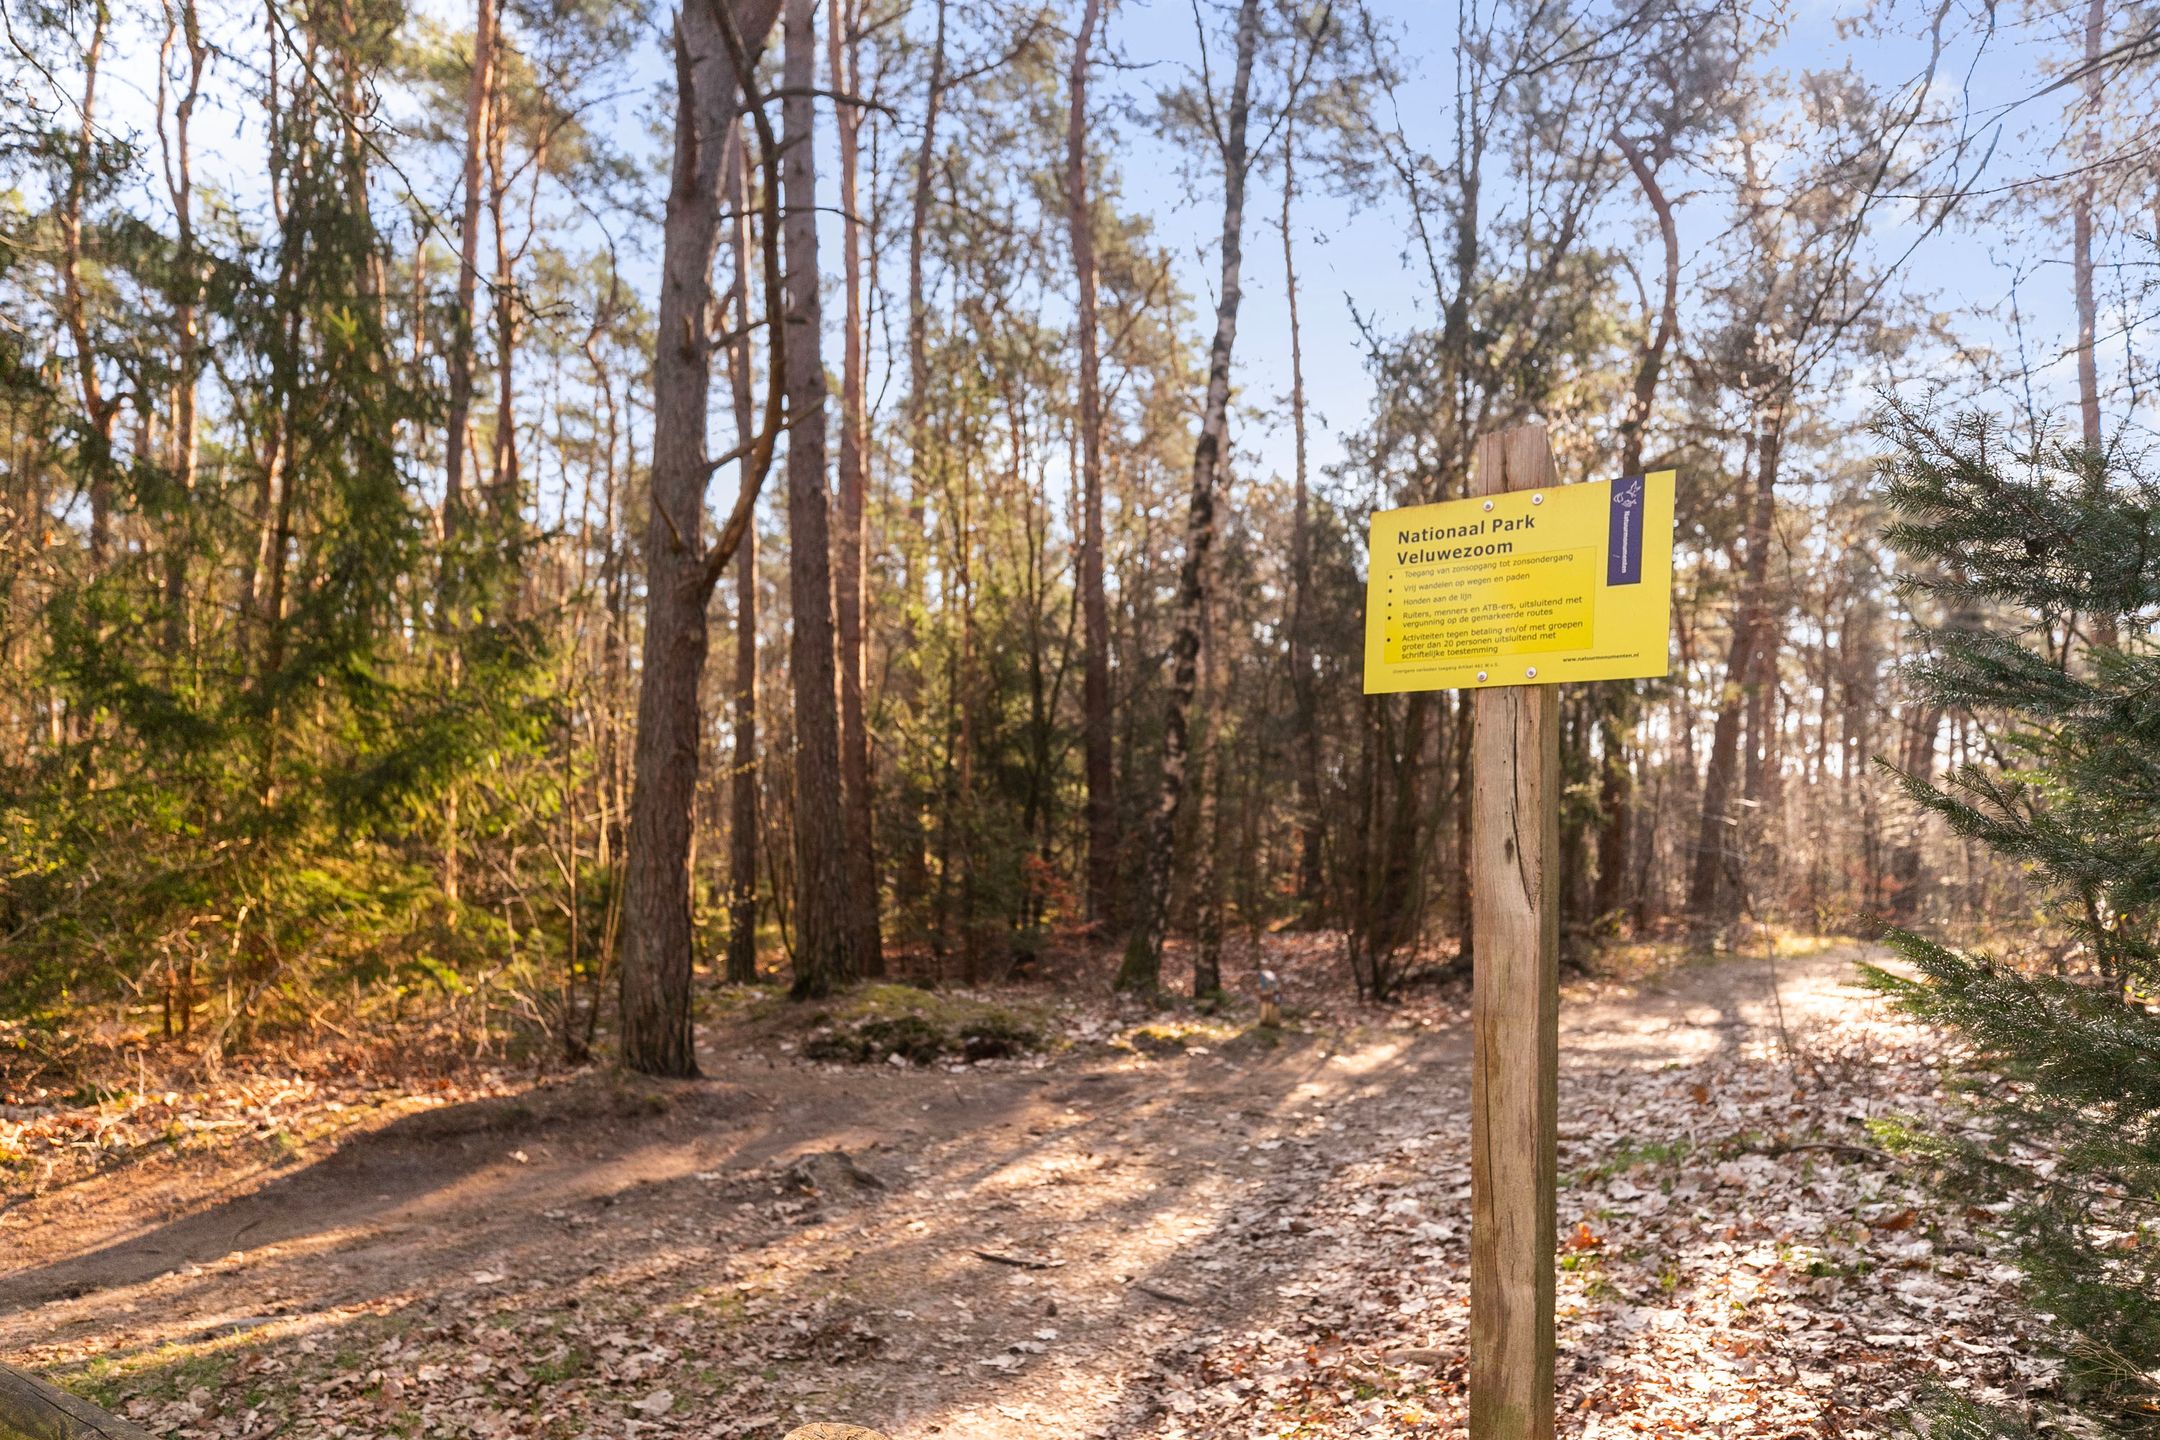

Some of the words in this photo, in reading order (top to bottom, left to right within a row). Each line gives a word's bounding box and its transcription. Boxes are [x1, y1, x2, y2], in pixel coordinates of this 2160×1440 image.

[1398, 520, 1485, 545] Nationaal
[1492, 514, 1536, 533] Park
[1622, 510, 1630, 574] Natuurmonumenten
[1397, 542, 1513, 565] Veluwezoom
[1405, 569, 1434, 578] Toegang
[1452, 562, 1497, 573] zonsopgang
[1512, 554, 1574, 565] zonsondergang
[1404, 585, 1416, 593] Vrij
[1419, 581, 1453, 590] wandelen
[1455, 580, 1465, 588] op
[1467, 576, 1492, 586] wegen
[1506, 572, 1530, 582] paden
[1403, 611, 1432, 619] Ruiters,
[1434, 607, 1468, 616] menners
[1482, 604, 1516, 612] ATB-ers,
[1519, 598, 1563, 609] uitsluitend
[1566, 596, 1582, 604] met
[1404, 598, 1431, 606] Honden
[1460, 592, 1472, 601] lijn
[1403, 618, 1445, 628] vergunning
[1471, 611, 1524, 622] gemarkeerde
[1526, 608, 1553, 616] routes
[1402, 632, 1444, 642] Activiteiten
[1446, 630, 1468, 639] tegen
[1470, 627, 1503, 637] betaling
[1505, 624, 1528, 633] en/of
[1530, 624, 1546, 632] met
[1548, 620, 1583, 631] groepen
[1402, 642, 1425, 652] groter
[1456, 637, 1492, 647] personen
[1494, 633, 1537, 643] uitsluitend
[1402, 650, 1445, 660] schriftelijke
[1447, 646, 1498, 656] toestemming
